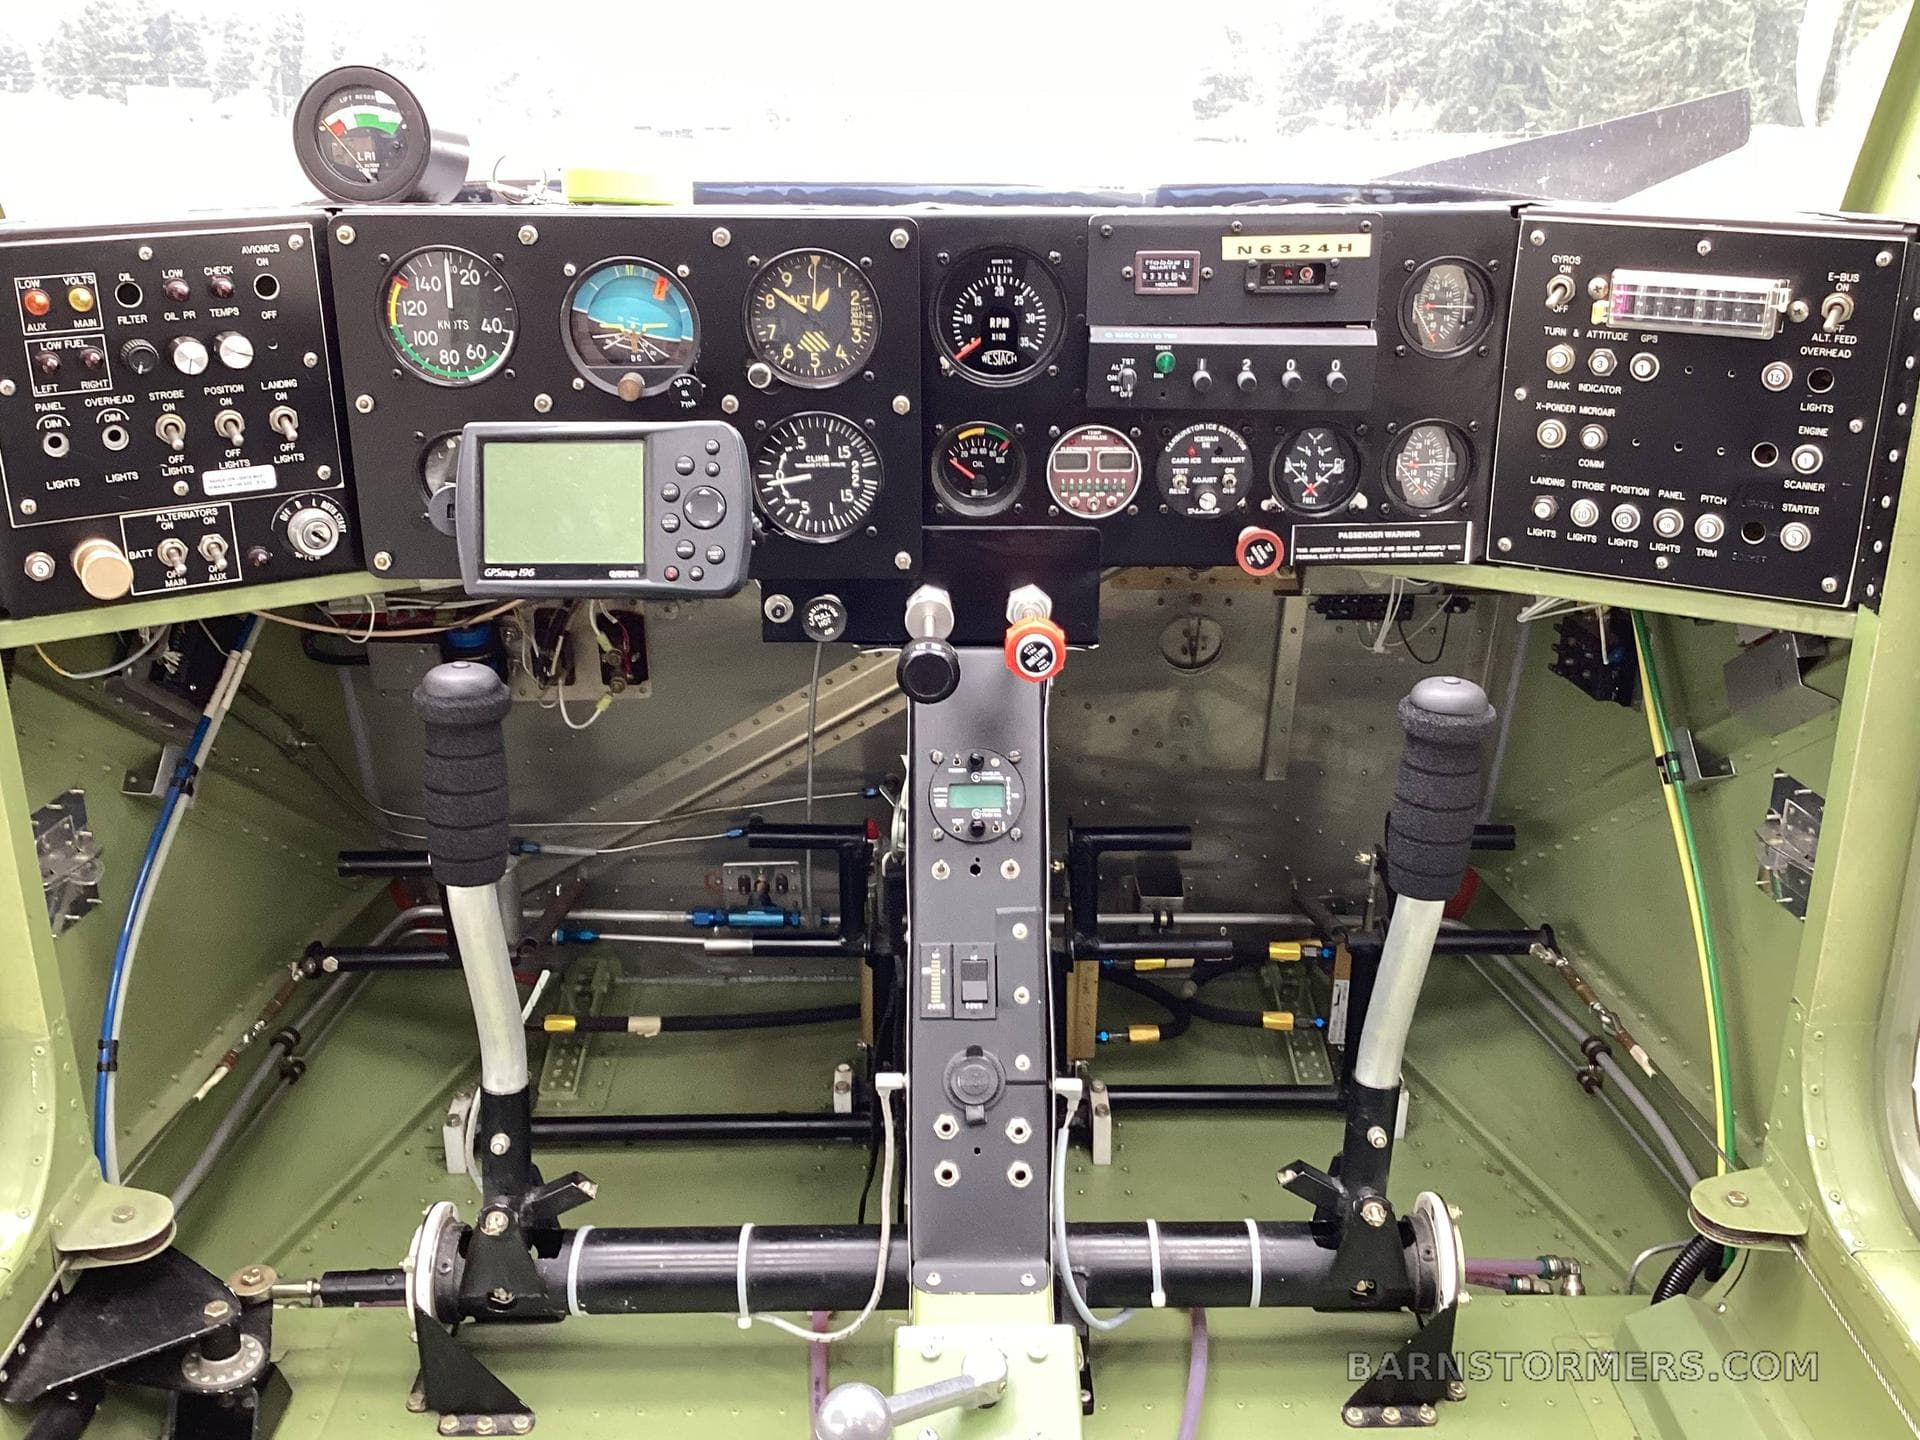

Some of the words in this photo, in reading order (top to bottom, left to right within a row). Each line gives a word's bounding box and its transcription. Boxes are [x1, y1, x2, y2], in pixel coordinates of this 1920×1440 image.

[357, 152, 376, 162] LRI
[241, 244, 280, 255] AVIONICS
[1237, 242, 1353, 256] N6324H
[256, 257, 269, 267] ON
[1551, 255, 1581, 265] GYROS
[162, 268, 183, 279] LOW
[204, 266, 233, 277] CHECK
[1559, 265, 1571, 273] ON
[18, 279, 40, 290] LOW
[63, 275, 95, 286] VOLTS
[118, 272, 135, 282] OIL
[460, 270, 480, 285] 20
[781, 272, 793, 288] 9
[837, 272, 842, 288] 1
[1827, 272, 1860, 283] E-BUS
[415, 276, 442, 292] 140
[1836, 282, 1849, 292] ON
[994, 286, 1004, 297] 20
[765, 294, 776, 310] 8
[850, 290, 860, 305] 2
[974, 296, 983, 307] 15
[1014, 296, 1024, 307] 25
[209, 307, 240, 318] TEMPS
[402, 300, 427, 317] 120
[1552, 304, 1569, 313] OFF
[117, 314, 148, 325] FILTER
[164, 311, 179, 321] OIL
[183, 310, 197, 320] PR
[261, 310, 278, 320] OFF
[963, 314, 973, 325] 10
[1026, 313, 1036, 324] 30
[26, 322, 47, 332] AUX
[73, 318, 97, 329] MAIN
[481, 318, 502, 334] 40
[989, 317, 1010, 329] RPM
[767, 324, 776, 340] 7
[851, 328, 862, 344] 3
[1544, 326, 1567, 336] TURN
[1573, 329, 1580, 337] &
[1586, 330, 1629, 341] ATTITUDE
[413, 330, 438, 346] 100
[1020, 337, 1030, 347] 35
[1640, 334, 1658, 344] GPS
[1811, 333, 1831, 343] ALT.
[1834, 334, 1857, 345] FEED
[40, 340, 60, 350] LOW
[64, 338, 88, 349] FUEL
[466, 344, 487, 360] 60
[783, 343, 794, 359] 6
[836, 344, 847, 358] 4
[1800, 346, 1852, 359] OVERHEAD
[439, 350, 460, 365] 80
[810, 352, 821, 368] 5
[981, 351, 1018, 366] WESTACH
[1242, 359, 1252, 371] 2
[1287, 359, 1295, 371] 0
[1331, 360, 1340, 371] 0
[1107, 374, 1118, 382] ON
[1770, 373, 1782, 382] 15
[35, 383, 59, 394] LEFT
[81, 379, 110, 390] RIGHT
[204, 384, 244, 395] POSITION
[260, 379, 298, 391] LANDING
[1547, 380, 1570, 391] BANK
[1578, 383, 1622, 395] INDICATOR
[149, 390, 185, 400] STROBE
[275, 392, 288, 401] ON
[84, 394, 135, 408] OVERHEAD
[220, 397, 233, 407] ON
[35, 402, 66, 412] PANEL
[162, 402, 176, 412] ON
[1535, 402, 1576, 414] X-PONDER
[1579, 406, 1616, 417] MICROAIR
[1800, 402, 1834, 414] LIGHTS
[104, 412, 121, 423] DIM
[45, 418, 62, 429] DIM
[1798, 426, 1829, 437] ENGINE
[1165, 424, 1204, 453] CARBURETOR
[1218, 425, 1247, 452] DETECTOR
[279, 442, 296, 452] OFF
[225, 449, 241, 458] OFF
[274, 453, 305, 465] LIGHTS
[805, 454, 830, 463] CLIMB
[168, 455, 185, 464] OFF
[218, 459, 251, 470] LIGHTS
[1211, 456, 1246, 464] SONALERT
[1578, 458, 1605, 469] COMM
[161, 466, 195, 477] LIGHTS
[851, 460, 860, 474] 2
[105, 472, 139, 483] LIGHTS
[851, 474, 860, 487] 2
[46, 478, 81, 490] LIGHTS
[1784, 480, 1826, 492] SCANNER
[1530, 476, 1566, 488] LANDING
[1571, 480, 1605, 492] STROBE
[1610, 484, 1650, 497] POSITION
[1658, 490, 1686, 501] PANEL
[1700, 494, 1727, 505] PITCH
[1302, 496, 1316, 504] FUEL
[1782, 504, 1820, 515] STARTER
[155, 508, 219, 523] ALTERNATORS
[203, 516, 216, 526] ON
[160, 521, 174, 531] ON
[1338, 531, 1384, 539] PASSENGER
[1384, 530, 1421, 538] WARNING
[1527, 528, 1557, 539] LIGHTS
[1567, 532, 1597, 544] LIGHTS
[1607, 537, 1639, 549] LIGHTS
[1650, 542, 1681, 554] LIGHTS
[128, 549, 153, 560] BATT
[1696, 548, 1718, 558] TRIM
[208, 572, 228, 582] AUX
[484, 568, 518, 578] GPSmap
[518, 568, 536, 577] 196
[165, 578, 187, 588] MAIN
[817, 618, 832, 628] HOT
